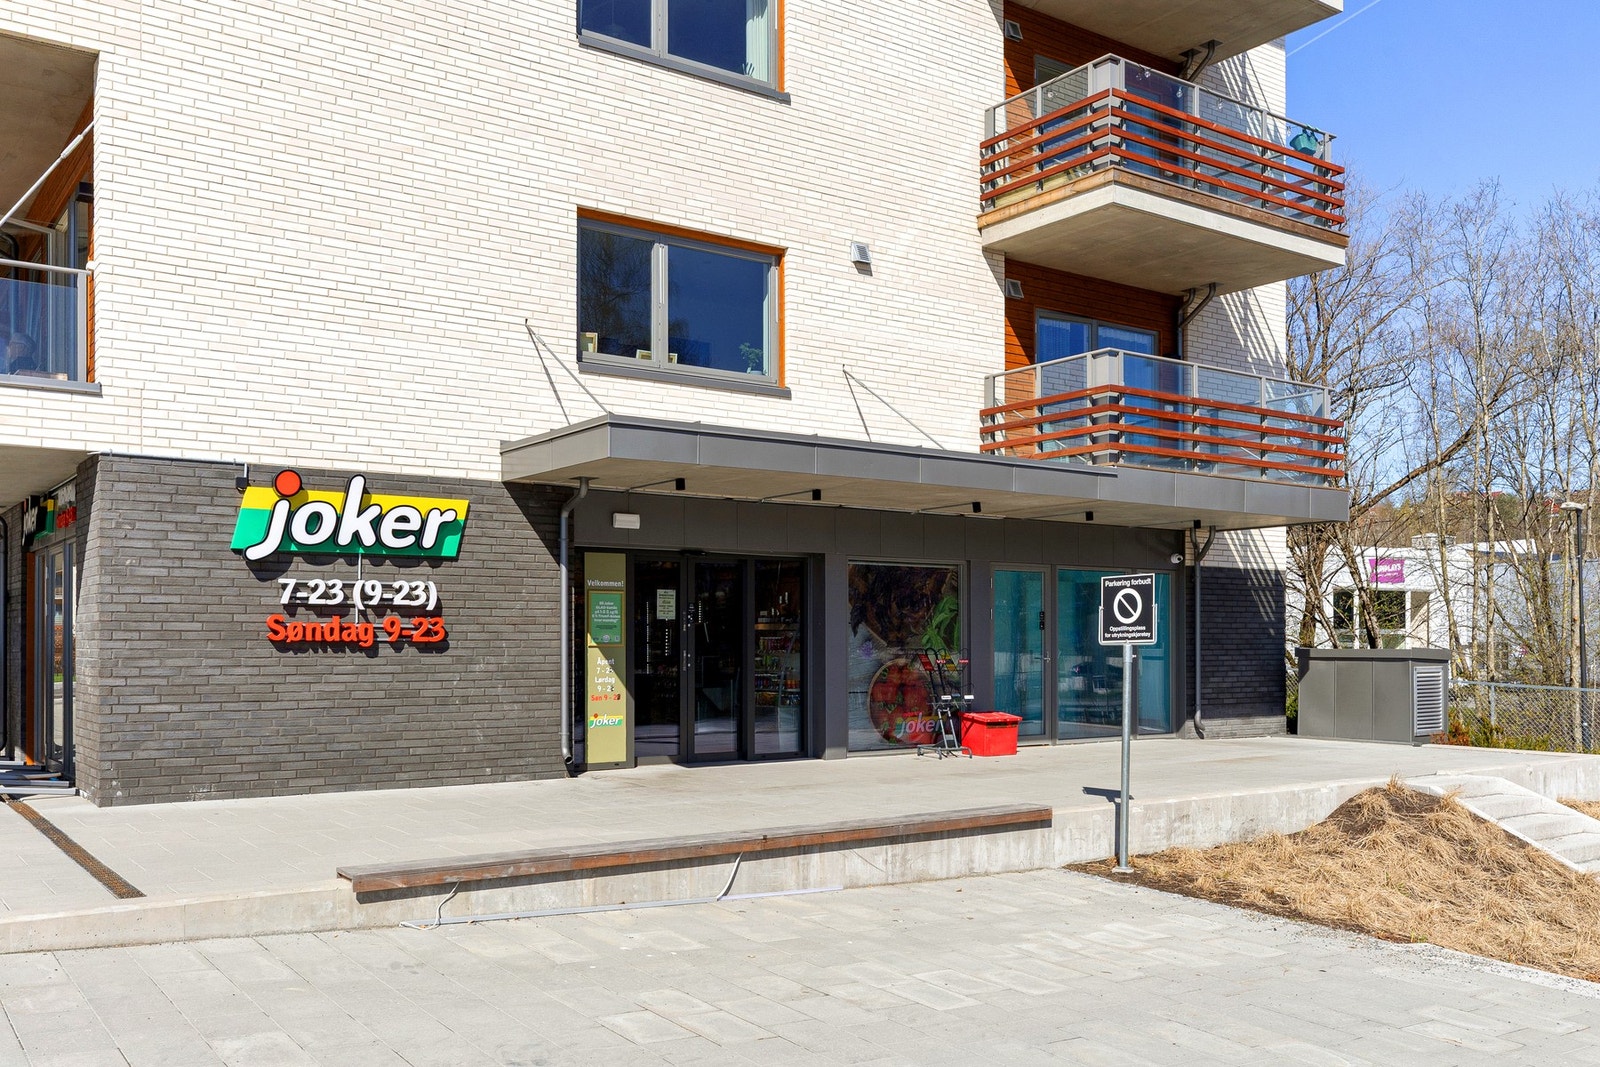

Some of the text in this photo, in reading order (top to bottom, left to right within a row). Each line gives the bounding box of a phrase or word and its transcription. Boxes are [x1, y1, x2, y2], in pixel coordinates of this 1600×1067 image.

[244, 469, 458, 561] joker
[278, 579, 437, 611] 7-23 (9-23)
[266, 614, 446, 647] Søndag 9-23
[597, 657, 615, 666] Åpent
[594, 676, 615, 684] Lørdag
[590, 713, 621, 729] joker
